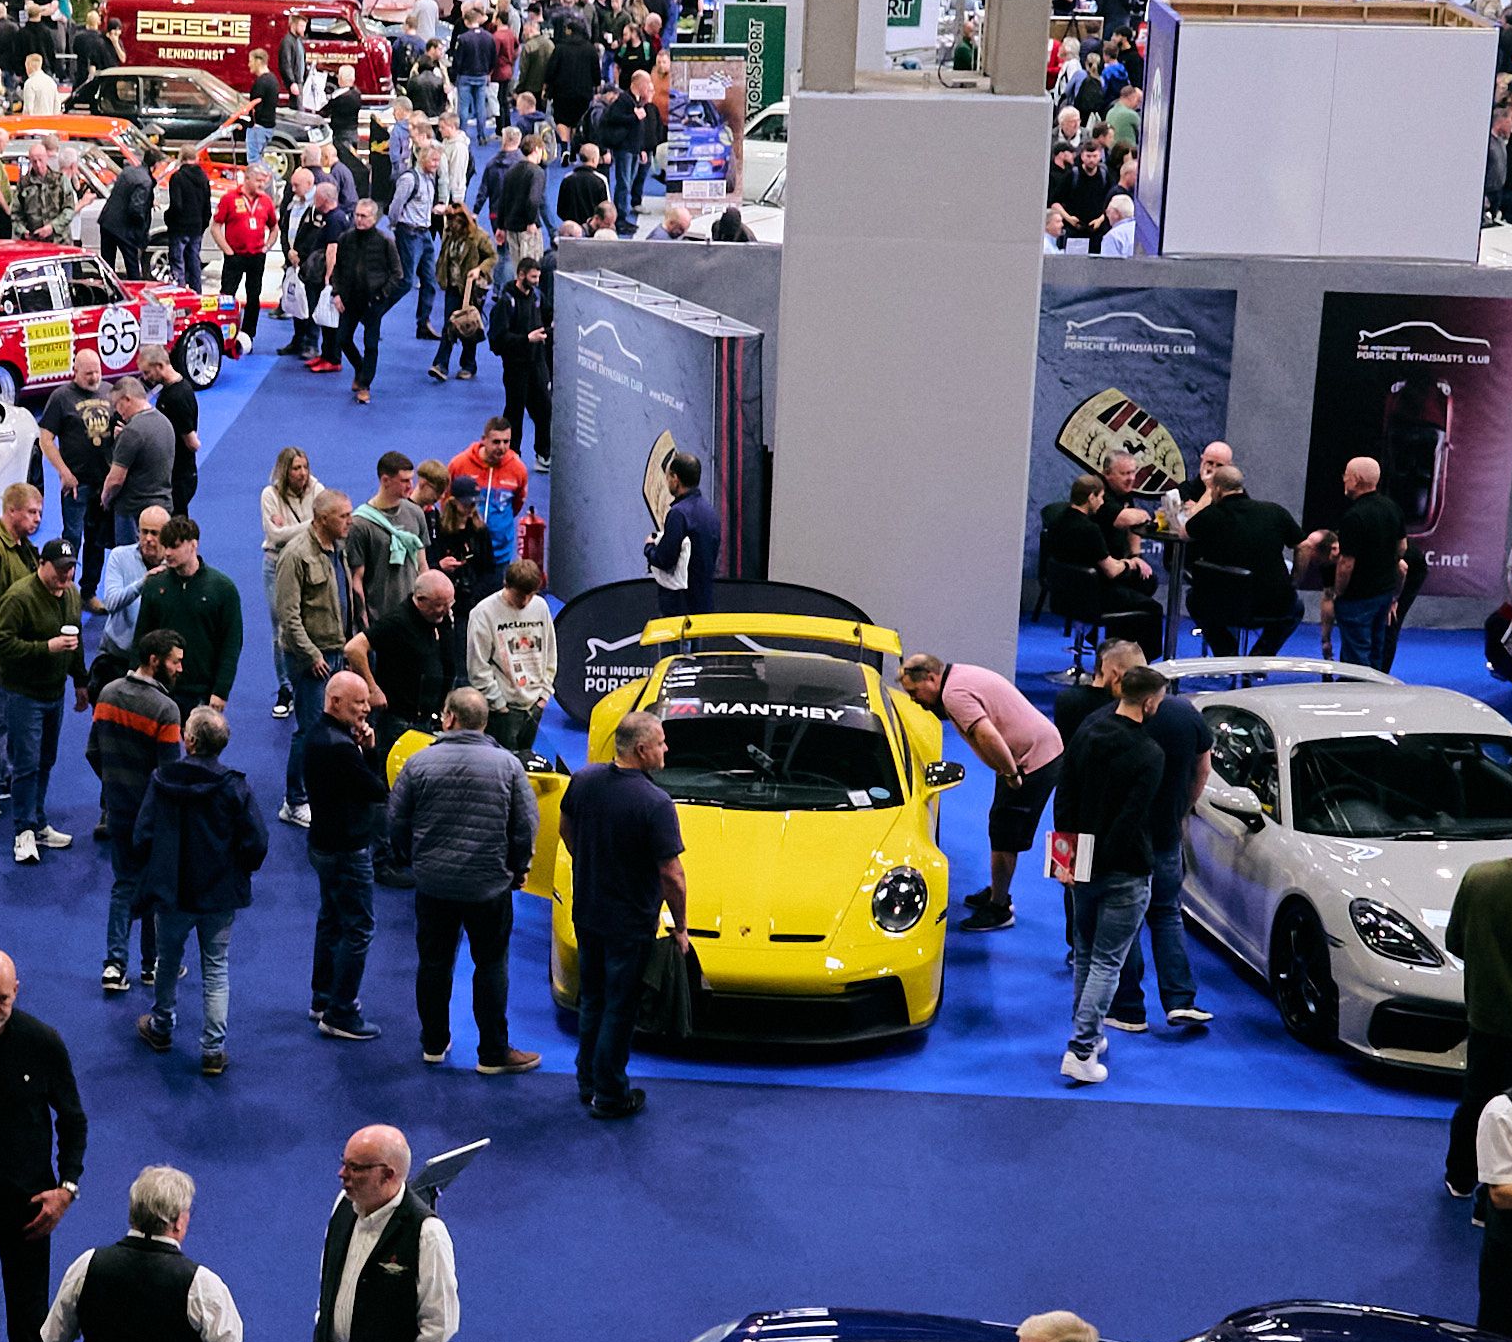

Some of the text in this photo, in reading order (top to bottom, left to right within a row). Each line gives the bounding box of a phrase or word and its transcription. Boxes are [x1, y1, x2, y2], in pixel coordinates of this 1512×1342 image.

[136, 17, 251, 38] PORSCHE
[158, 48, 226, 61] RENNDIENST
[99, 320, 139, 357] 35
[1064, 341, 1196, 354] PORSCHE ENTHUSIASTS CLUB
[1357, 350, 1490, 365] PORSCHE ENTHUSIASTS CLUB
[497, 620, 545, 631] McLaren
[585, 665, 654, 677] THE INDEPE
[702, 702, 845, 721] MANTHEY
